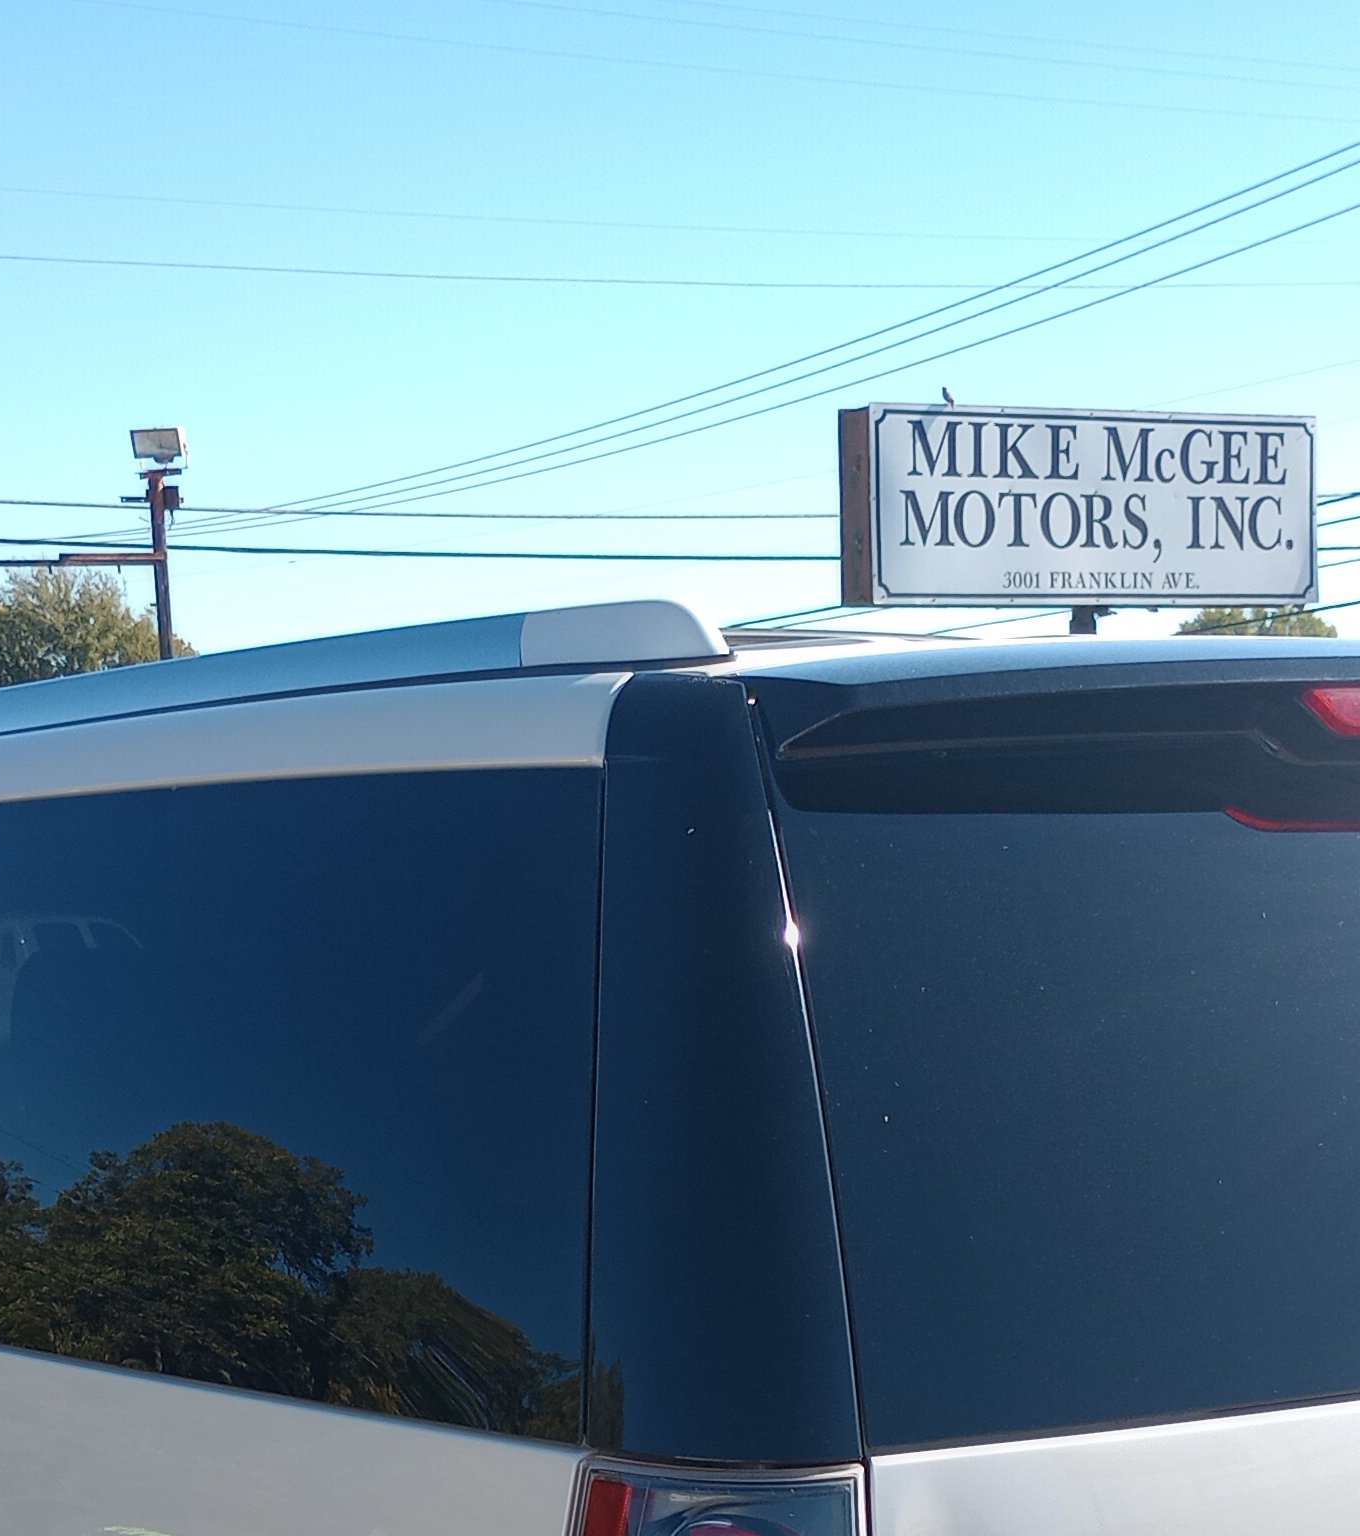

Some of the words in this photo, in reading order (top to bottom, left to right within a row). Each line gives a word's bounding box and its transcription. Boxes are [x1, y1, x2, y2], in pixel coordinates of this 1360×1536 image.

[907, 419, 1080, 481] MIKE
[1102, 426, 1287, 485] McGEE
[899, 489, 1163, 563] MOTORS,
[1186, 495, 1294, 551] INC.
[1002, 572, 1042, 589] 3001
[1049, 572, 1154, 590] FRANKLIN
[1161, 573, 1200, 590] AVE.
